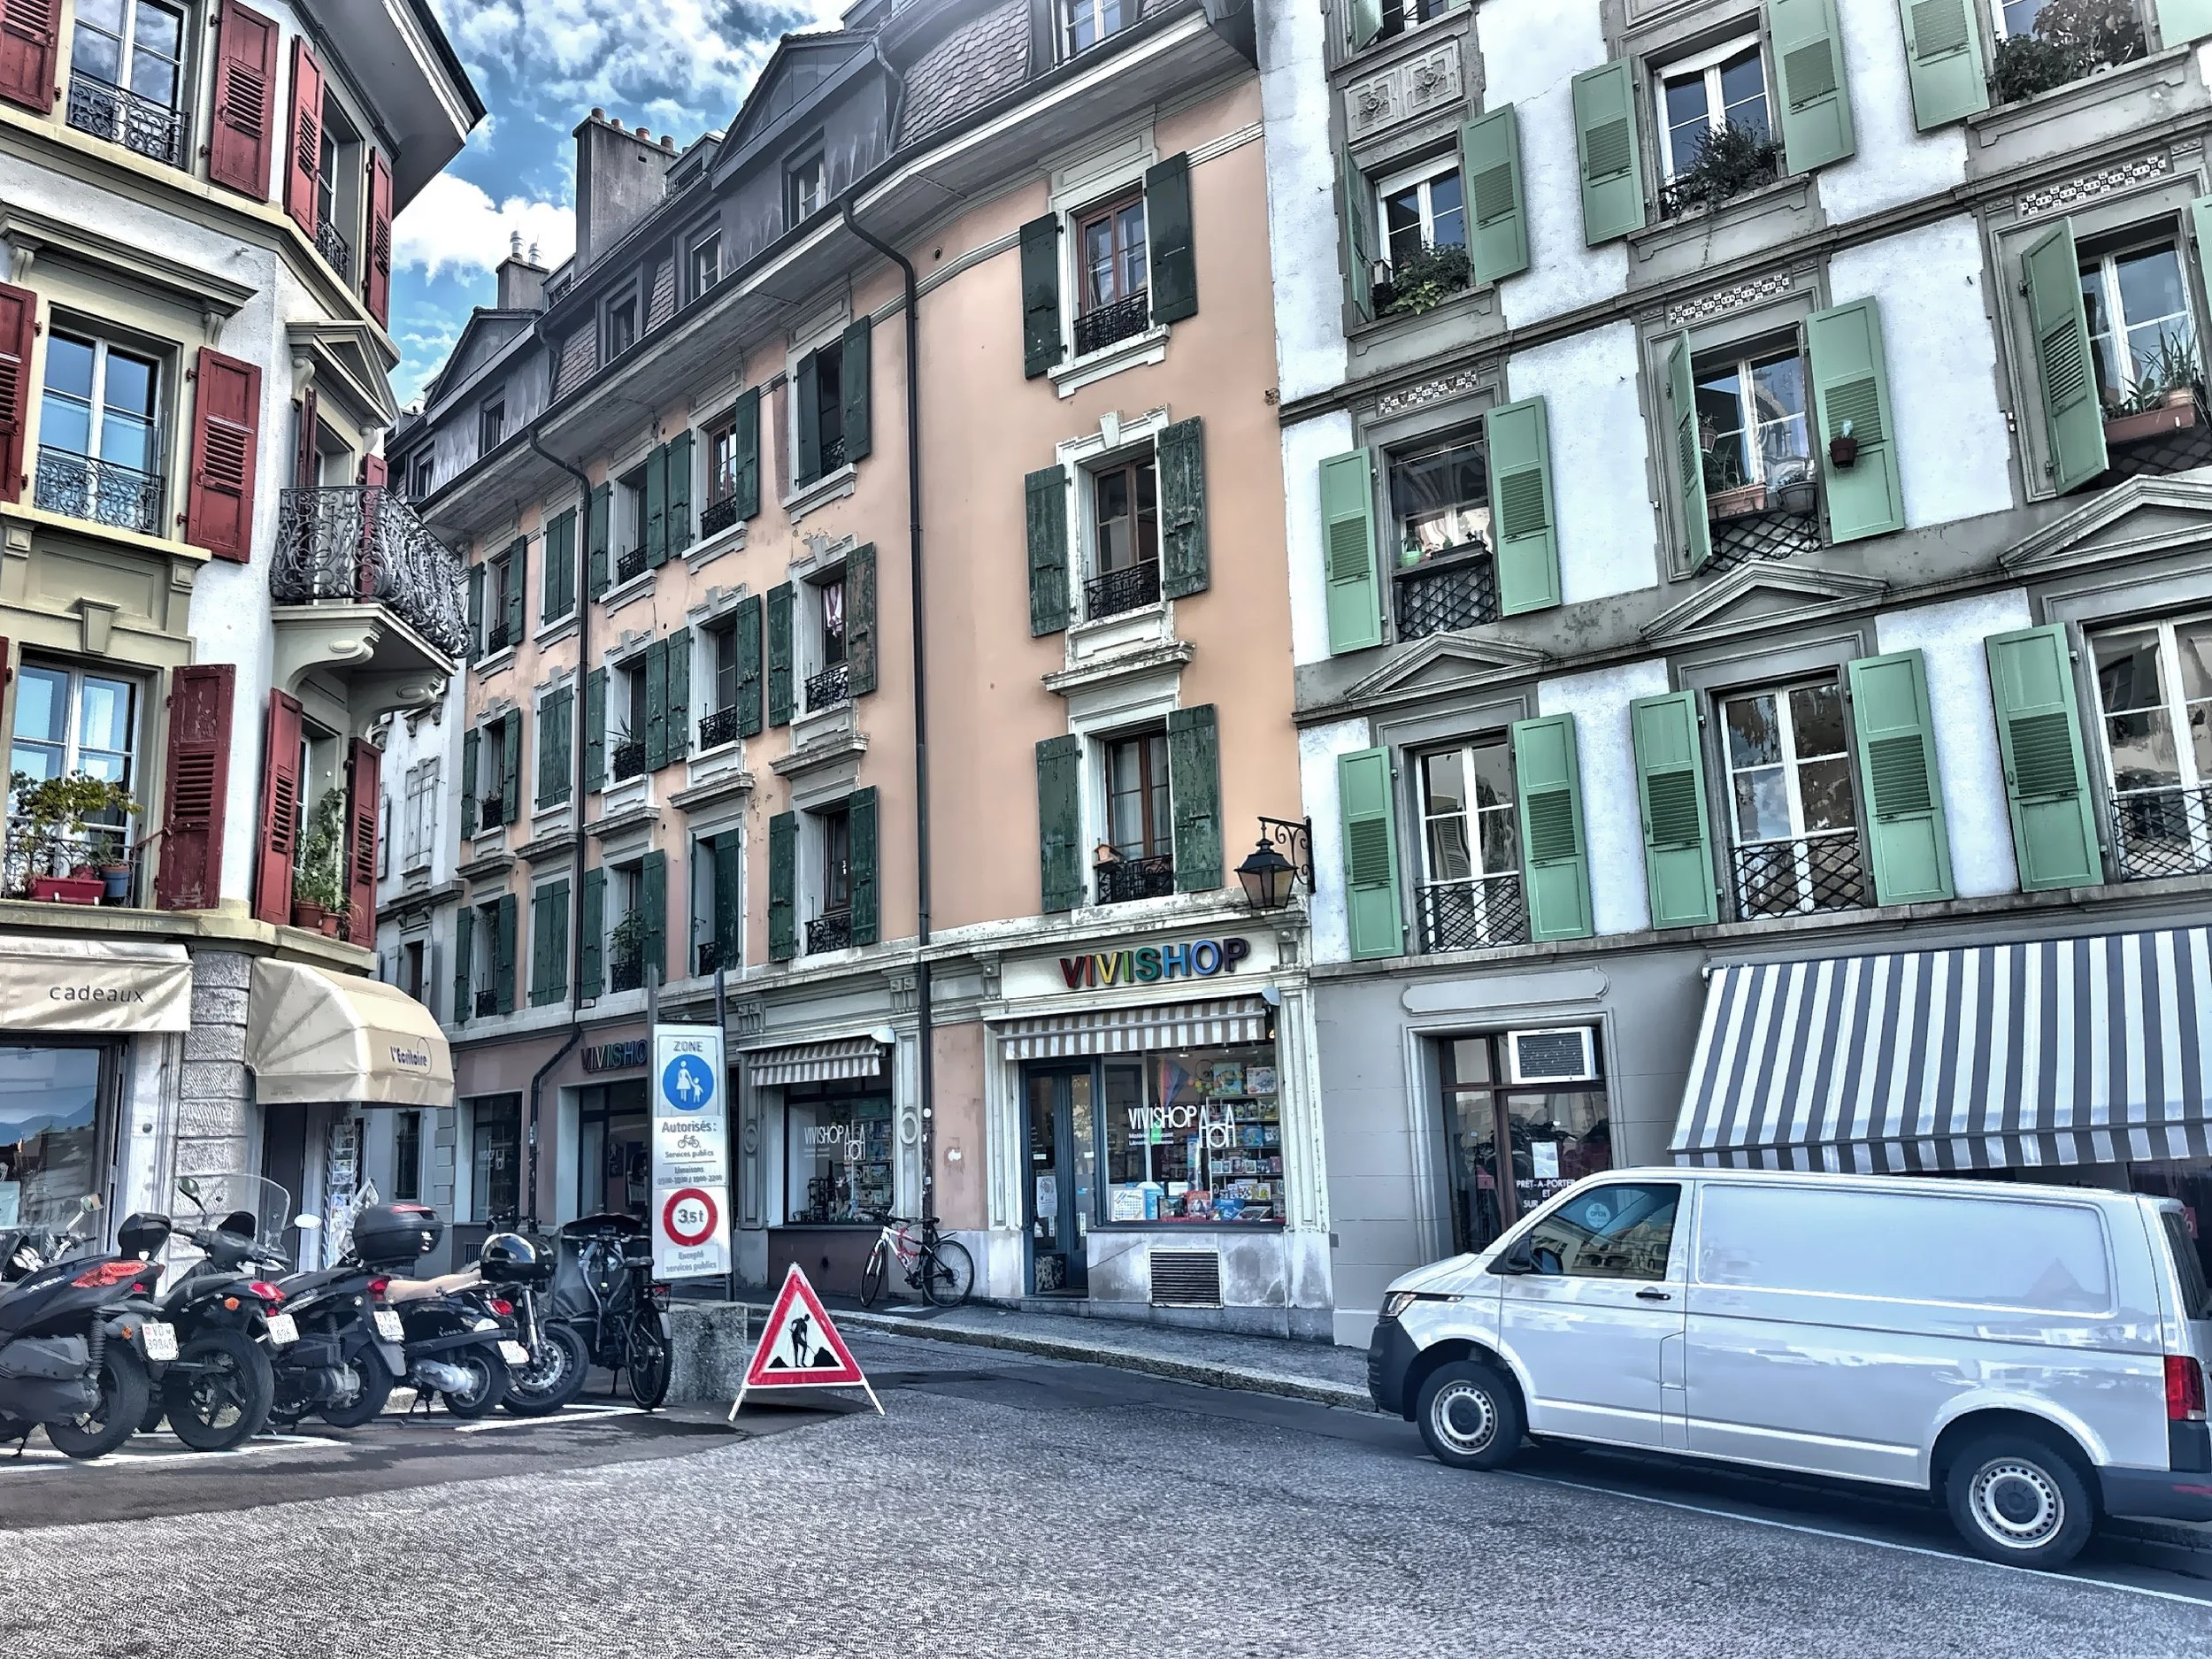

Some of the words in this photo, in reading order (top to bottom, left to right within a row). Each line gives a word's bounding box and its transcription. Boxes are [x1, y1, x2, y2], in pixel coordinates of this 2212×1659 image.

[1060, 937, 1250, 988] VIVISHOP
[50, 985, 144, 1002] cadeaux
[580, 1039, 648, 1071] VIVISHO
[673, 1041, 703, 1052] ZONE
[1128, 1105, 1197, 1130] VIVISHOP
[803, 1125, 844, 1145] VIVISHOP
[692, 1149, 714, 1158] publics
[1542, 1189, 1551, 1198] ET
[665, 1263, 692, 1272] services
[694, 1261, 717, 1271] publics
